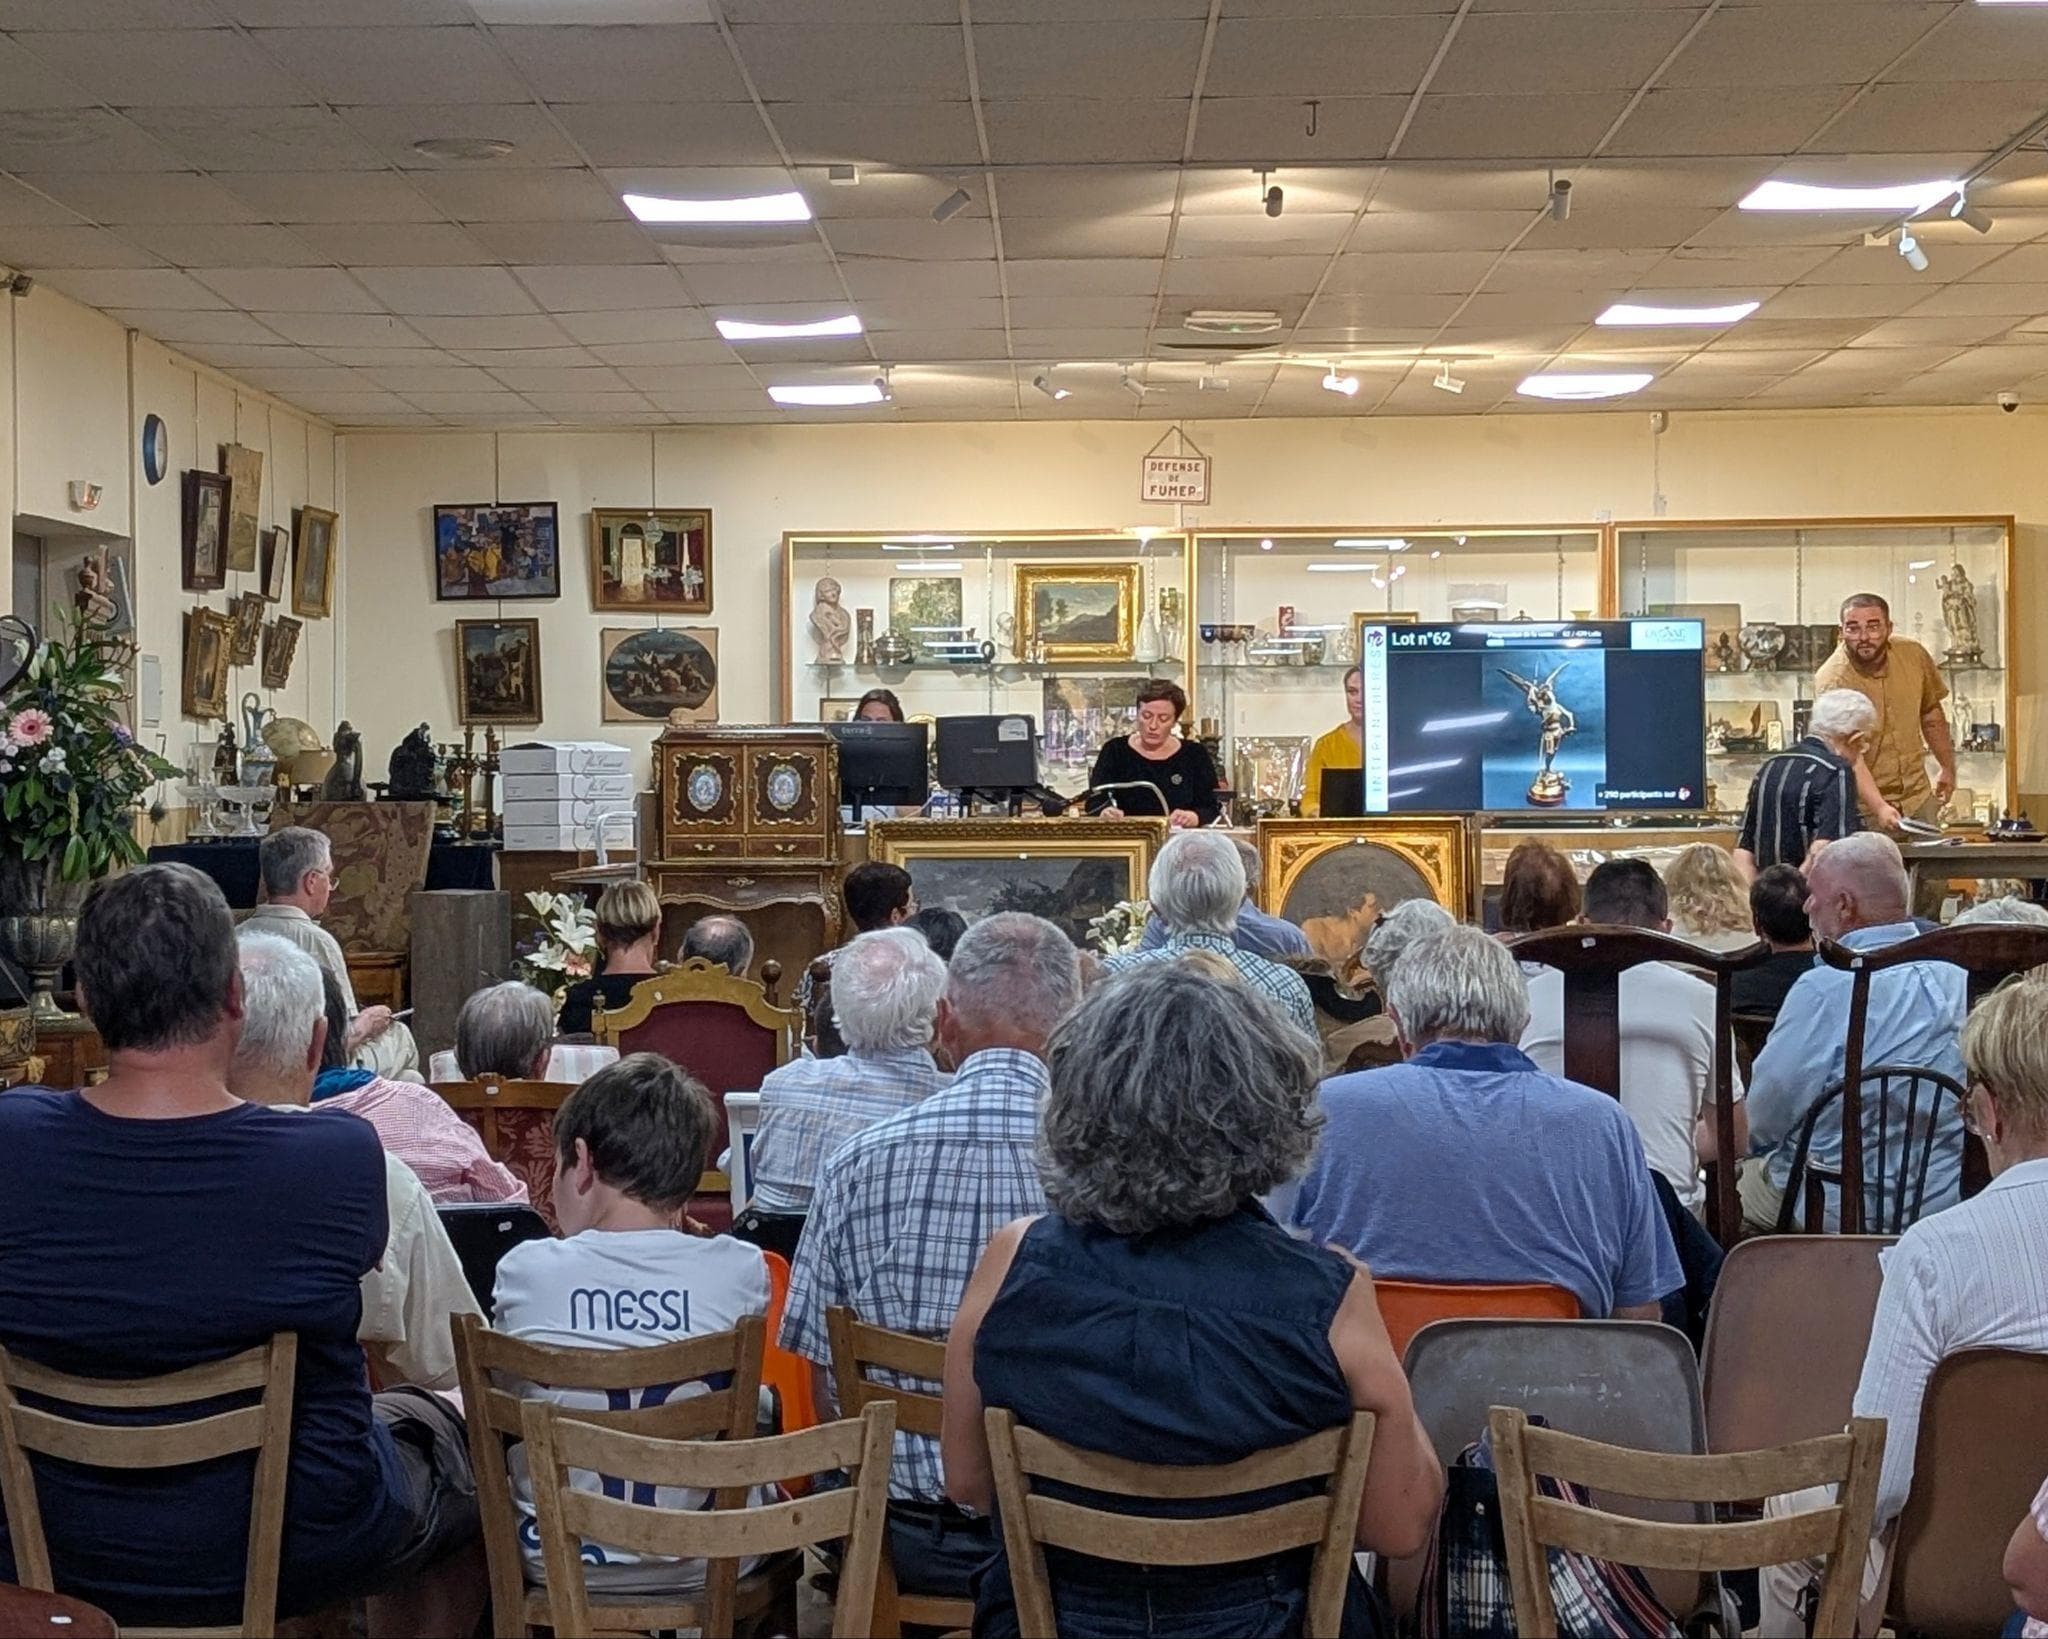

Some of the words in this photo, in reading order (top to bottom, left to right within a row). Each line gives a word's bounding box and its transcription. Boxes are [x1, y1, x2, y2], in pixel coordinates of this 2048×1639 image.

[1150, 462, 1201, 472] DEFENSE
[1391, 632, 1415, 646] Lot
[1417, 631, 1452, 646] n°62
[570, 1288, 690, 1332] MESSI
